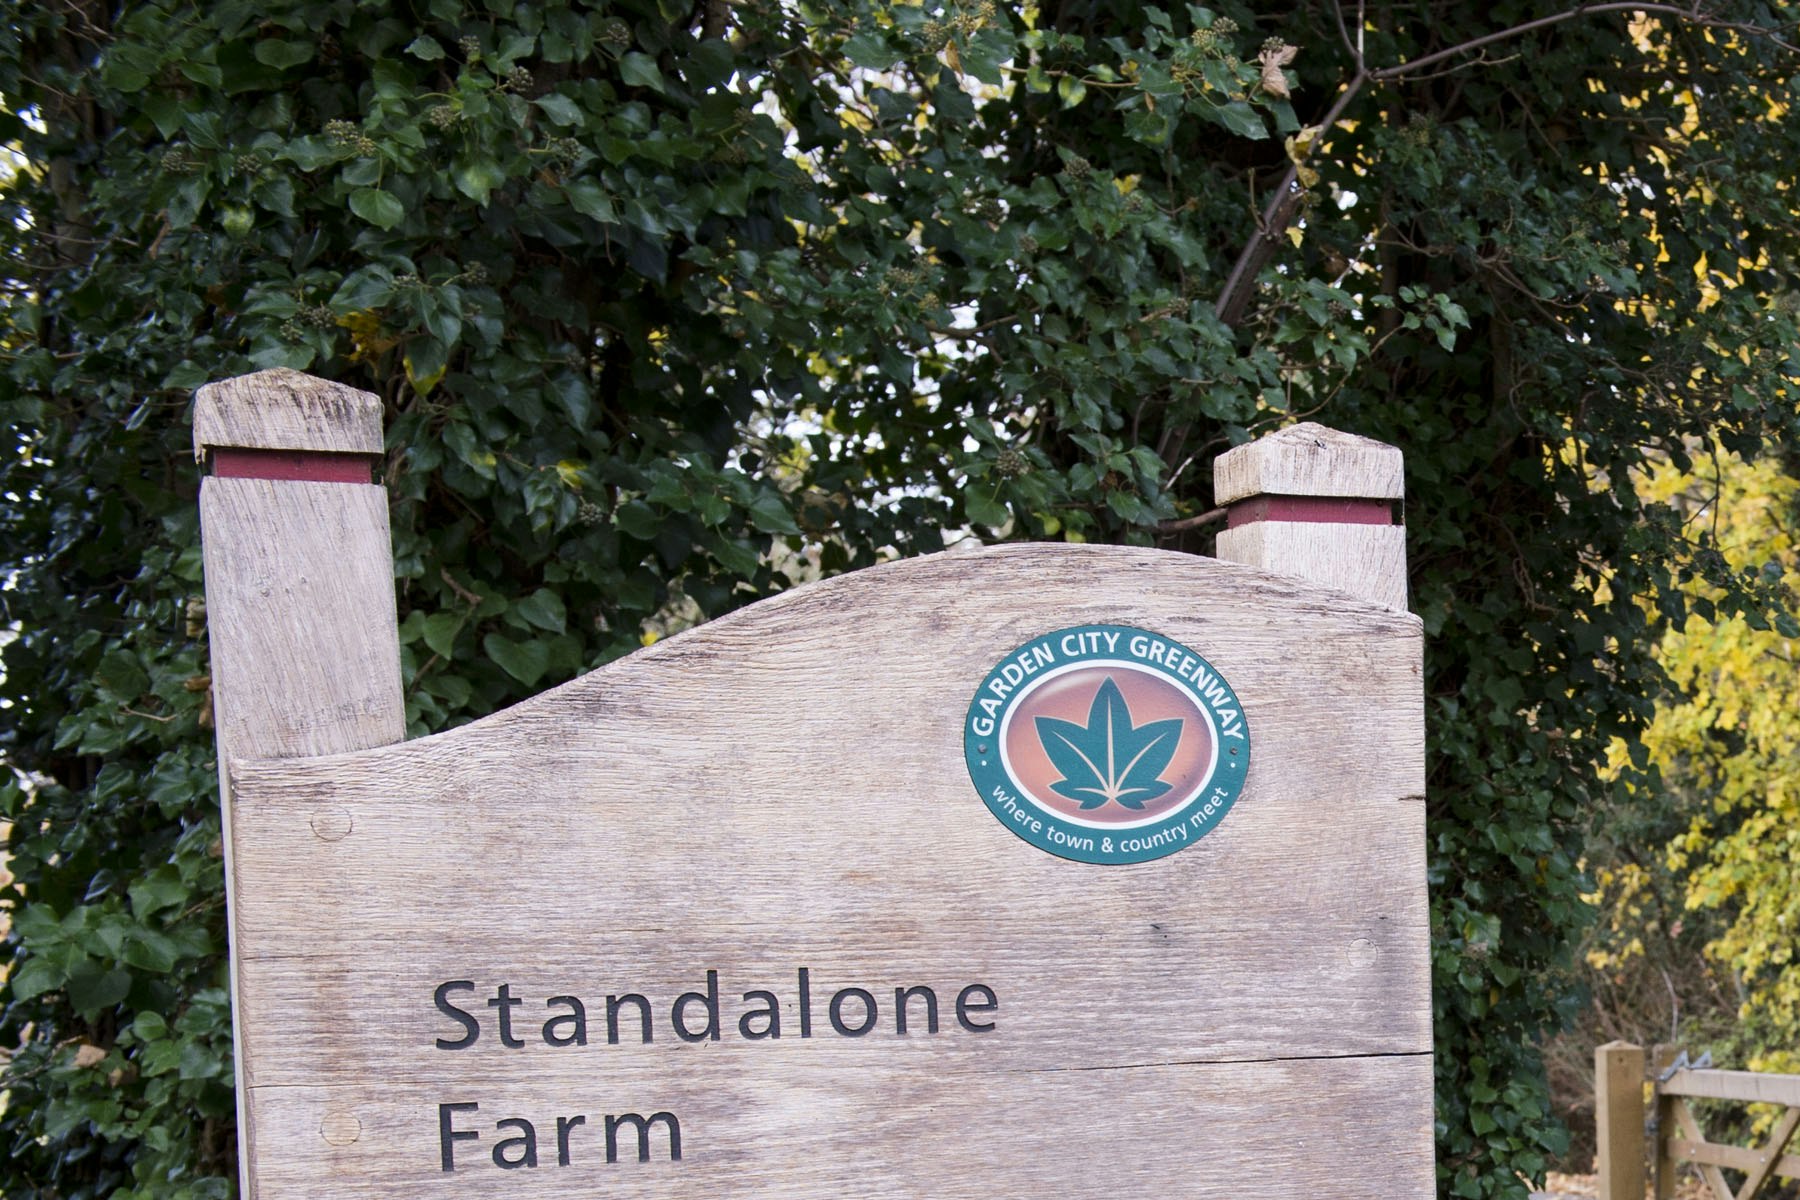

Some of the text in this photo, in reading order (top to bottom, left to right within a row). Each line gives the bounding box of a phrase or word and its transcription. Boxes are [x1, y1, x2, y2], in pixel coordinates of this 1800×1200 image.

[972, 632, 1244, 741] GARDEN CITY GREENWAY
[992, 785, 1229, 853] where town & country meet
[434, 967, 998, 1051] Standalone
[438, 1102, 682, 1172] Farm
